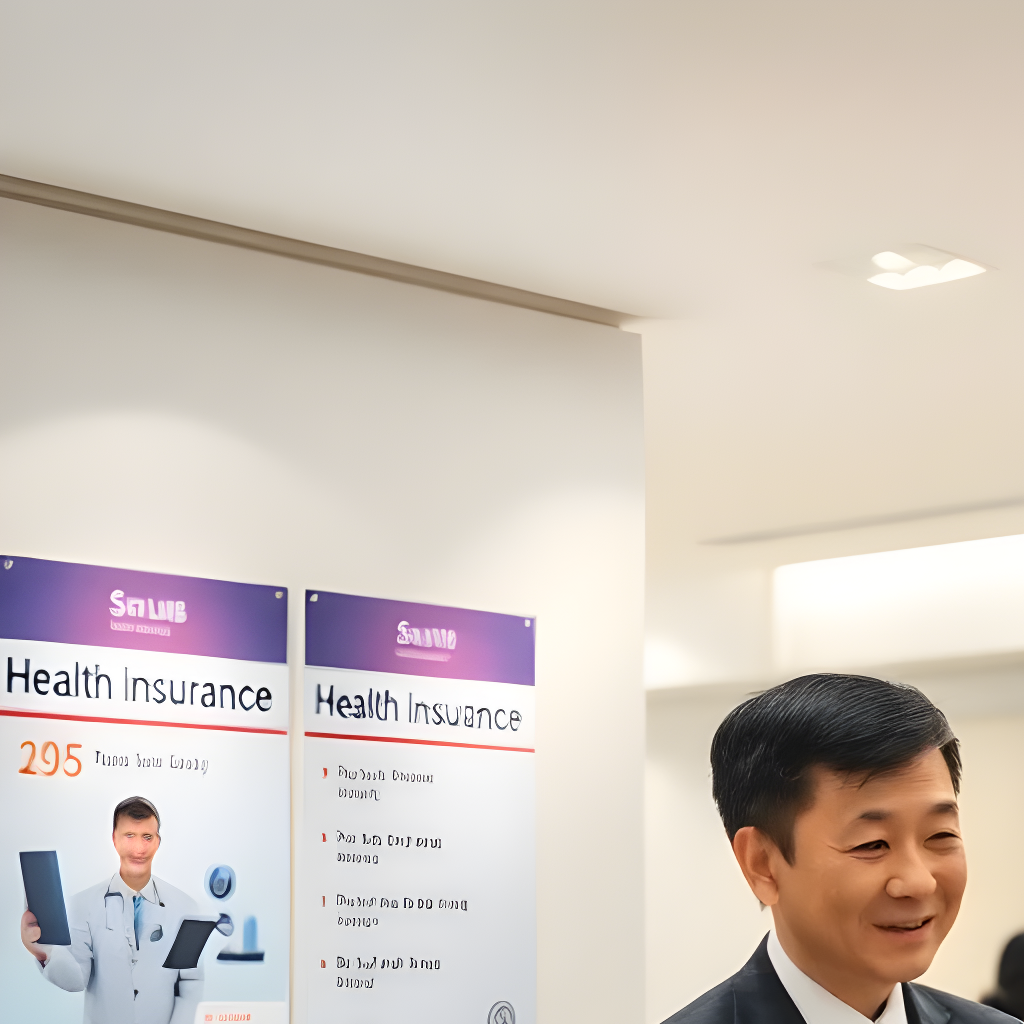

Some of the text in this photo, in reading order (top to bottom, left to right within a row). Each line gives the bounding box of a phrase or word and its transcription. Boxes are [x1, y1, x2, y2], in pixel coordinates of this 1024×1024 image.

[7, 656, 273, 711] Health Insurance
[315, 683, 399, 721] Health
[18, 741, 82, 777] 295
